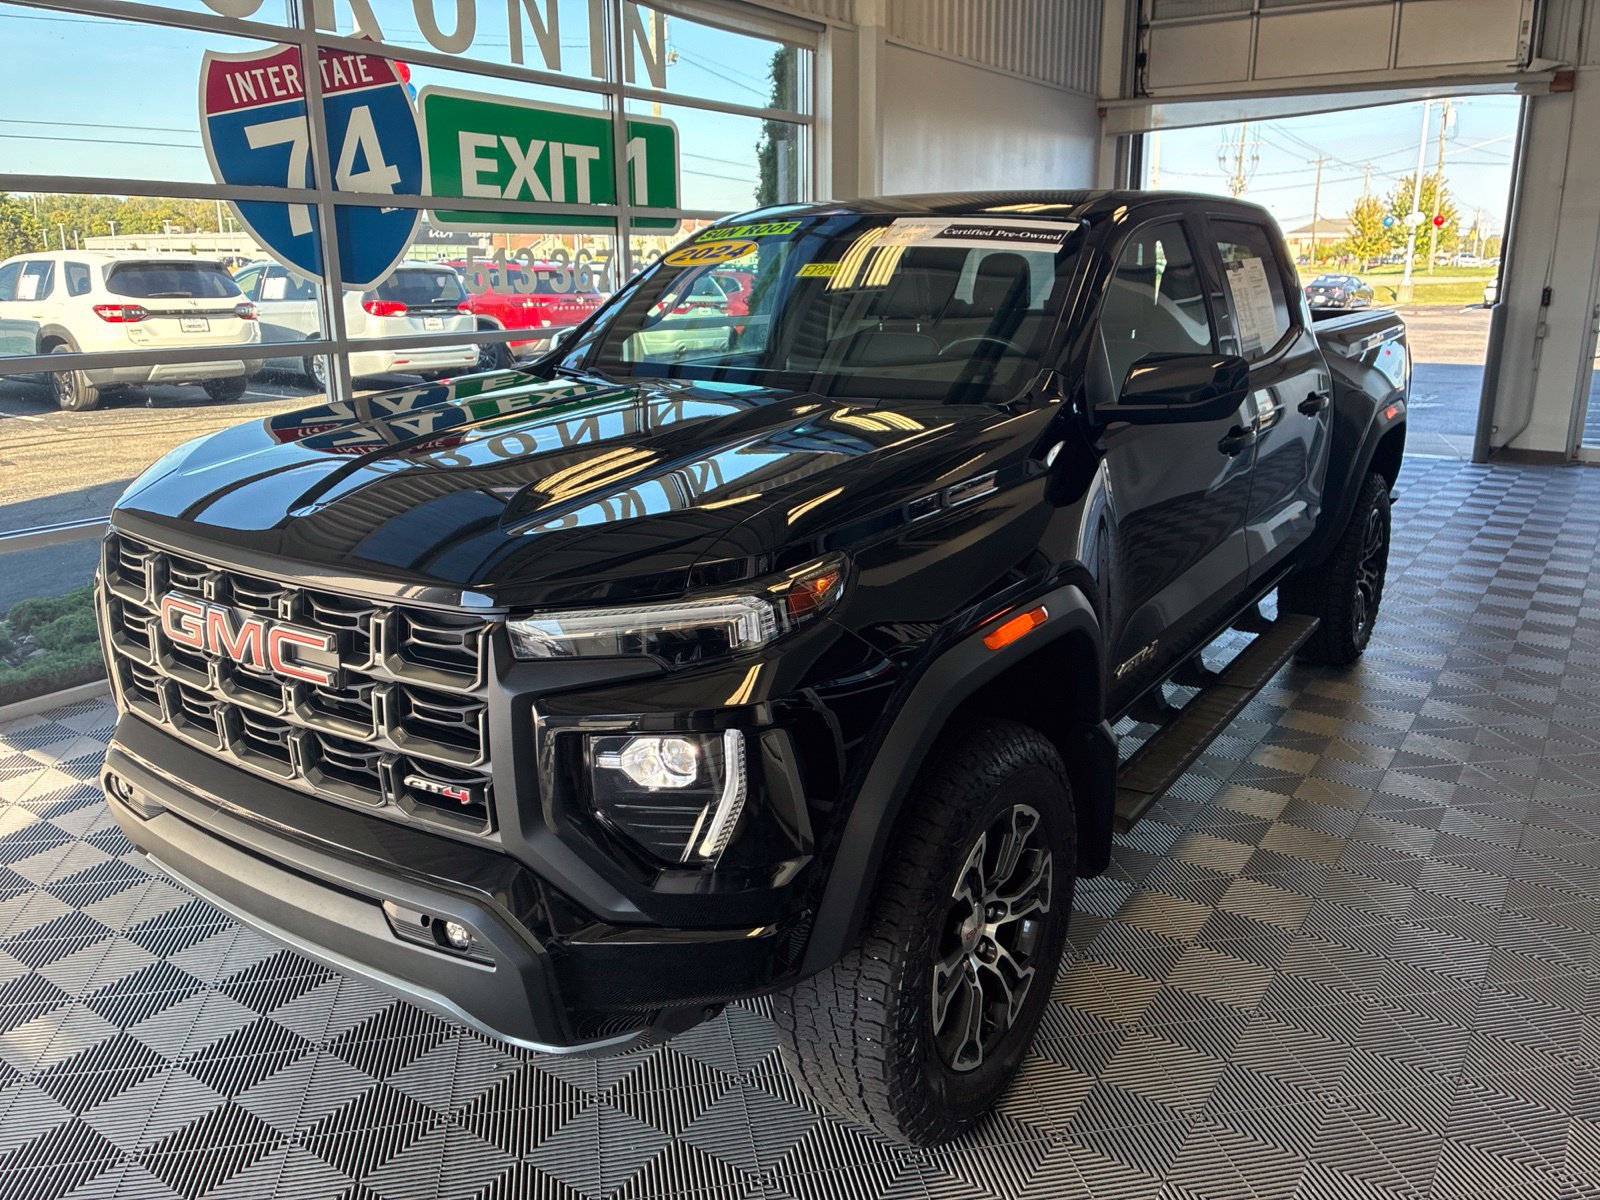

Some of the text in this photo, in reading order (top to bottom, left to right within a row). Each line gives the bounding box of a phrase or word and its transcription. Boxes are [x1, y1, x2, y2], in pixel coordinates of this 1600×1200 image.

[225, 55, 373, 104] INTERTATE
[244, 105, 401, 237] 74
[458, 130, 649, 206] EXIT 1
[672, 243, 751, 262] 2024
[701, 222, 796, 240] SUN ROOF
[943, 227, 994, 238] Certified
[994, 229, 1063, 241] Pre-Owned
[161, 590, 336, 688] GMC
